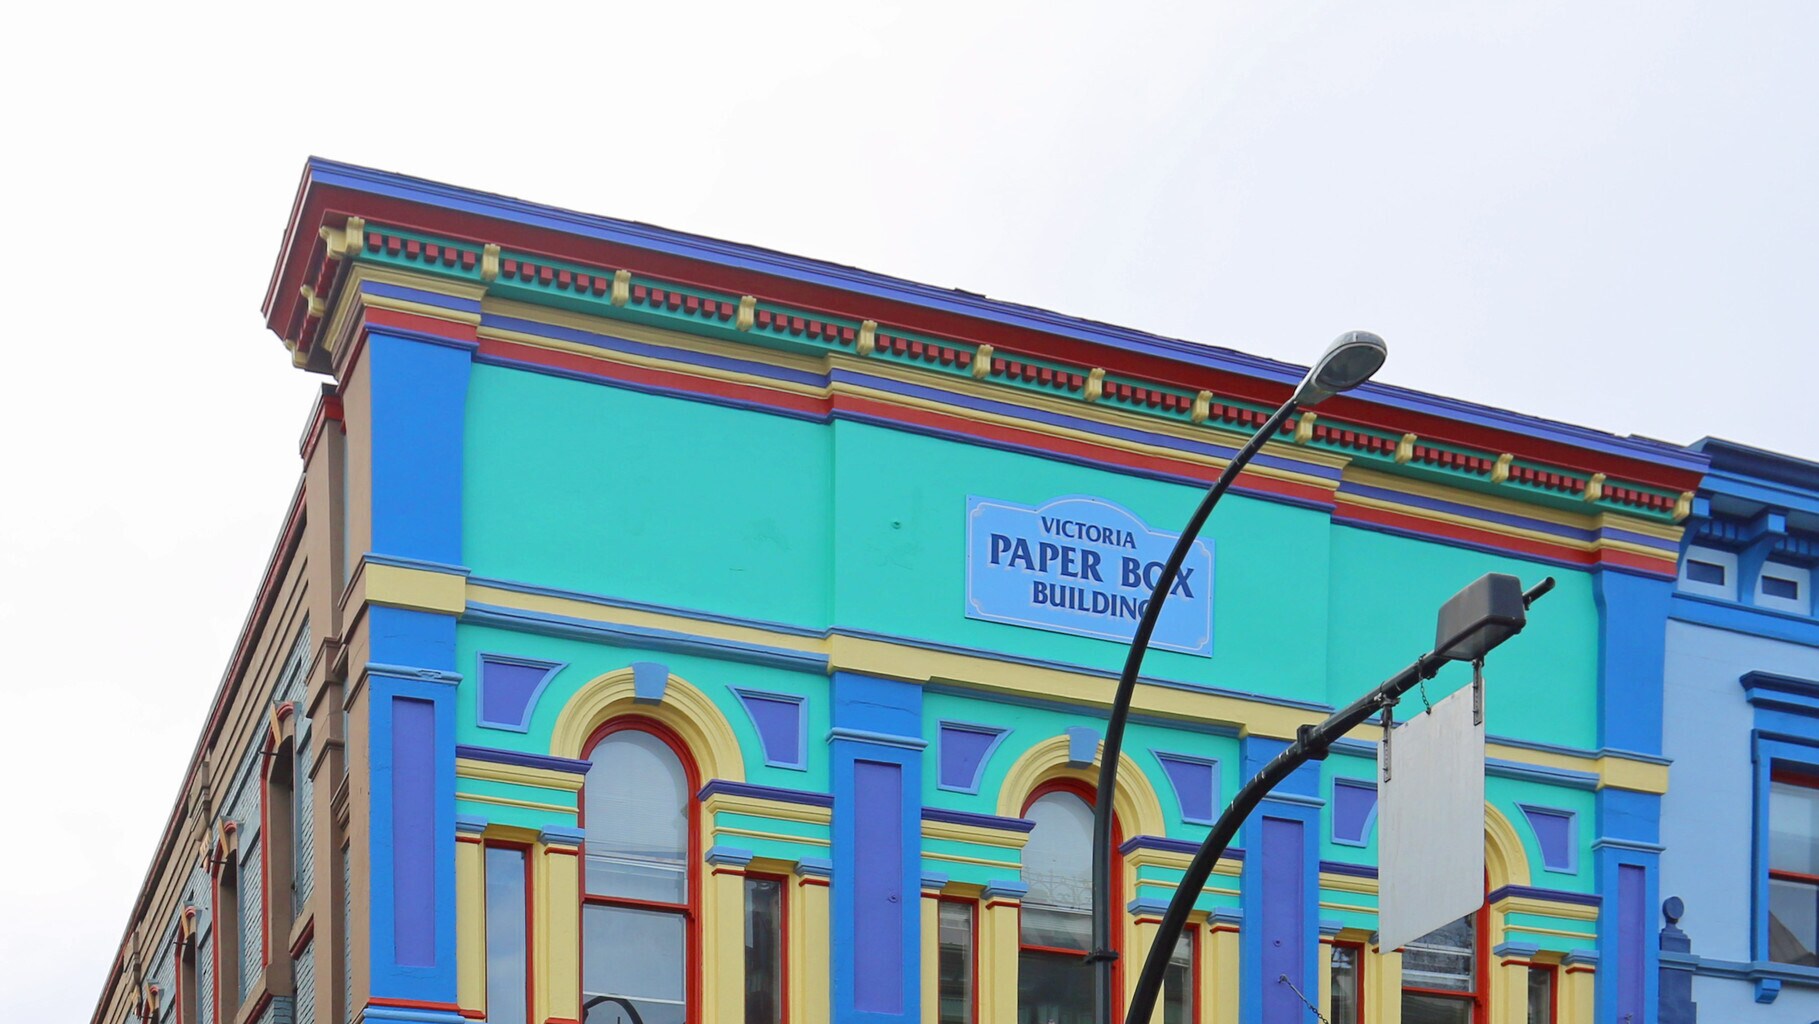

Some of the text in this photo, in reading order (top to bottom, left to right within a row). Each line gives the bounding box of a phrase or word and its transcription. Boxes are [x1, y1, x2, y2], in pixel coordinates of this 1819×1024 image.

[1041, 516, 1136, 549] VICTORIA
[989, 533, 1194, 598] PAPER BOX
